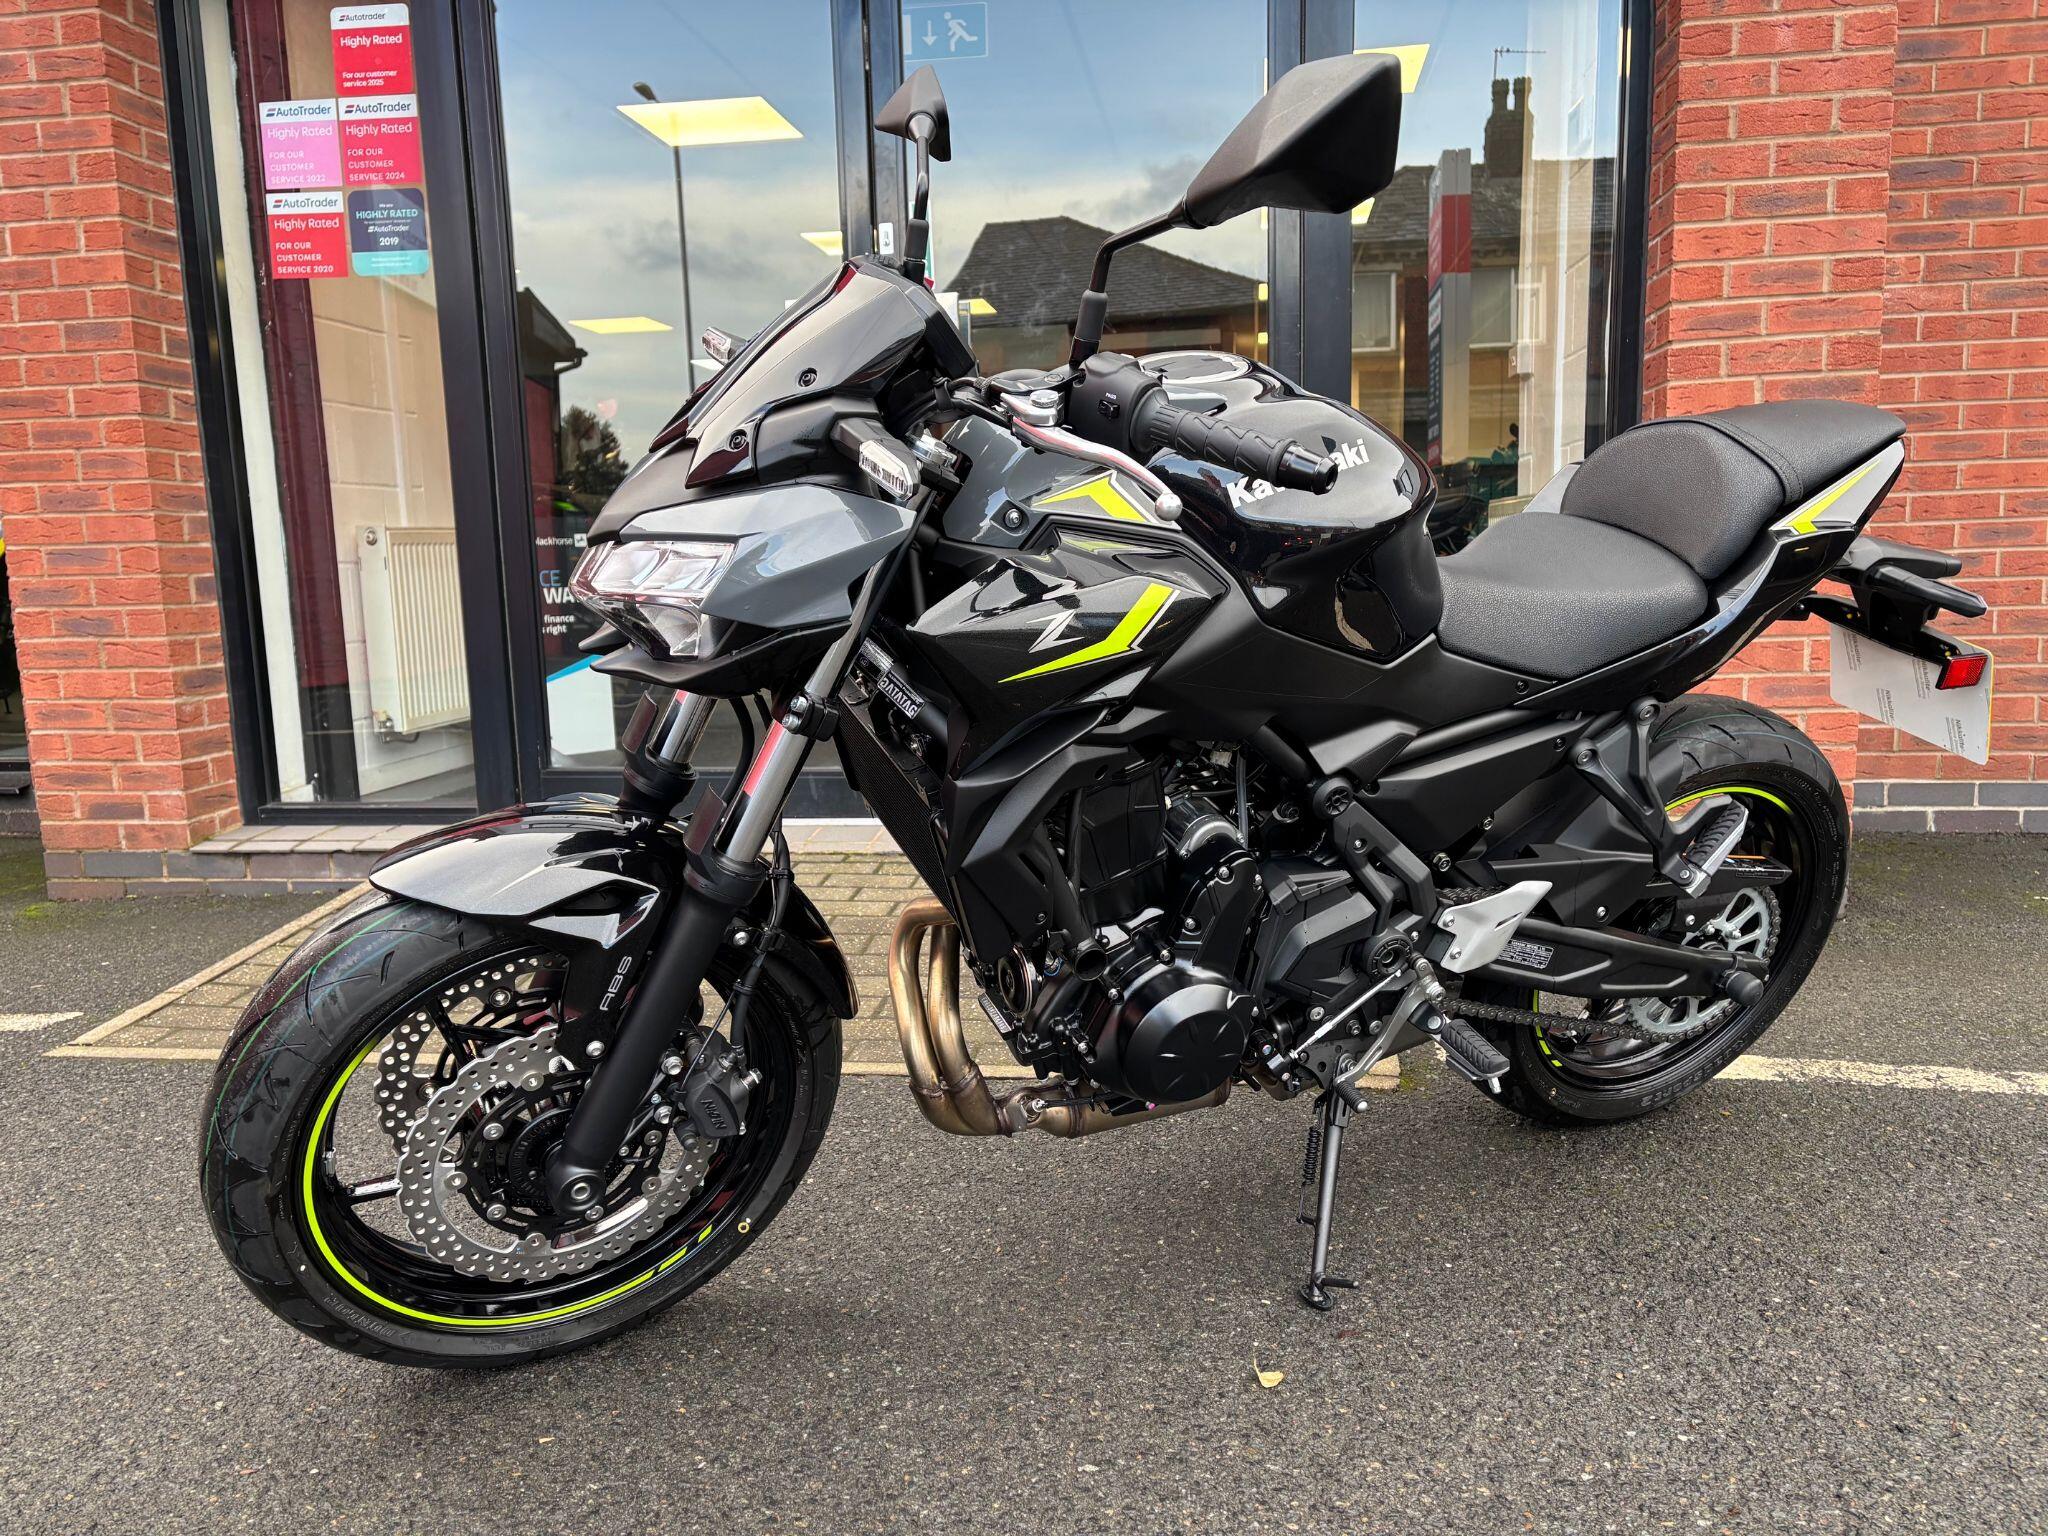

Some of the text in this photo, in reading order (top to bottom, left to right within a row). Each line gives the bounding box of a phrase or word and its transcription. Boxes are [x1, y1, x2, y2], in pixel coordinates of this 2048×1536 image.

[345, 12, 386, 21] Autotrader
[340, 33, 403, 48] Highly Rated
[276, 105, 331, 117] AutoTrader
[355, 102, 411, 114] AutoTrader
[267, 126, 333, 141] Highly Rated
[345, 123, 412, 138] Highly Rated
[269, 151, 285, 159] FOR
[366, 148, 383, 156] OUR
[270, 163, 314, 172] CUSTOMER
[348, 160, 394, 169] CUSTOMER
[271, 176, 304, 184] SERVICE
[349, 171, 405, 181] SERVICE 2024
[282, 197, 338, 209] AutoTrader
[356, 209, 418, 219] HIGHLY RATED
[274, 218, 340, 232] Highly Rated
[374, 224, 409, 233] AutoTrader
[275, 242, 312, 250] FOR OUR
[379, 237, 399, 246] 2019
[276, 253, 322, 262] CUSTOMER
[277, 265, 334, 274] SERVICE 2020
[1226, 438, 1370, 508] Kaaki
[543, 587, 581, 604] WA
[544, 614, 575, 624] finance
[546, 623, 567, 635] right
[879, 677, 918, 717] DATATAG
[600, 955, 633, 1012] ABS
